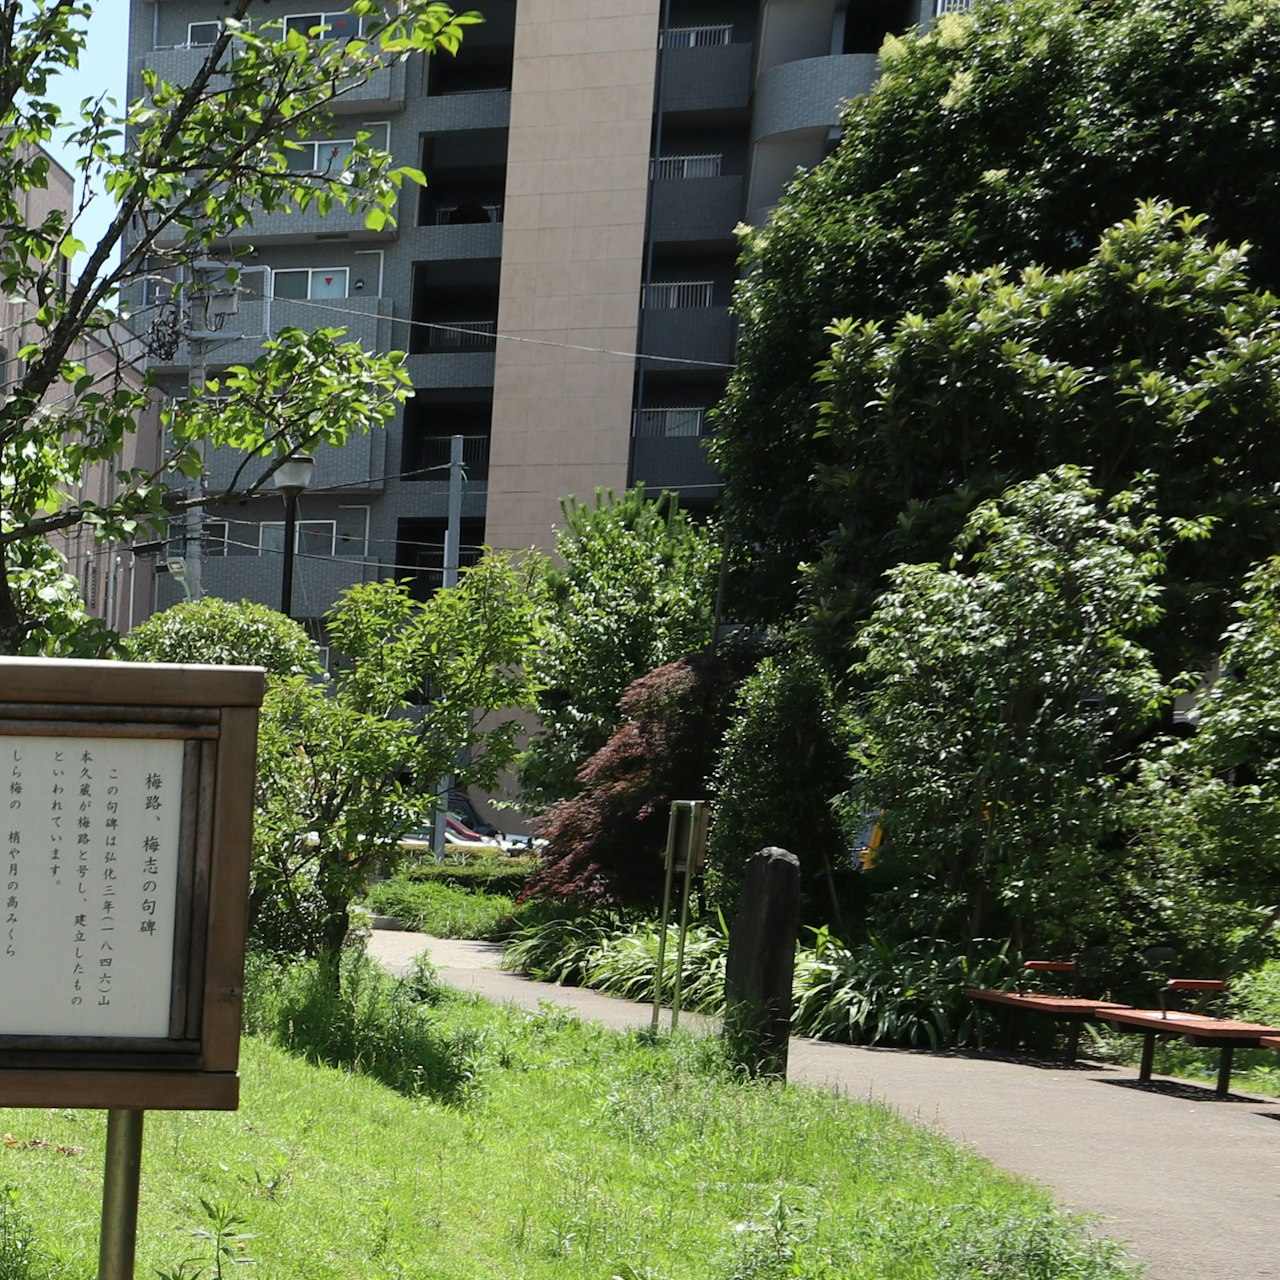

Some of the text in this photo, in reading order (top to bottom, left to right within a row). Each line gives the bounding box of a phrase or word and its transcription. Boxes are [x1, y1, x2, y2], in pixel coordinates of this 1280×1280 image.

[5, 749, 23, 957] しら梅の 梢や月の高みくら
[49, 751, 65, 886] といわれています。
[71, 749, 94, 1006] 本久蔵が梅路と号し、建立したもの
[138, 772, 164, 937] 梅路、梅志の句碑
